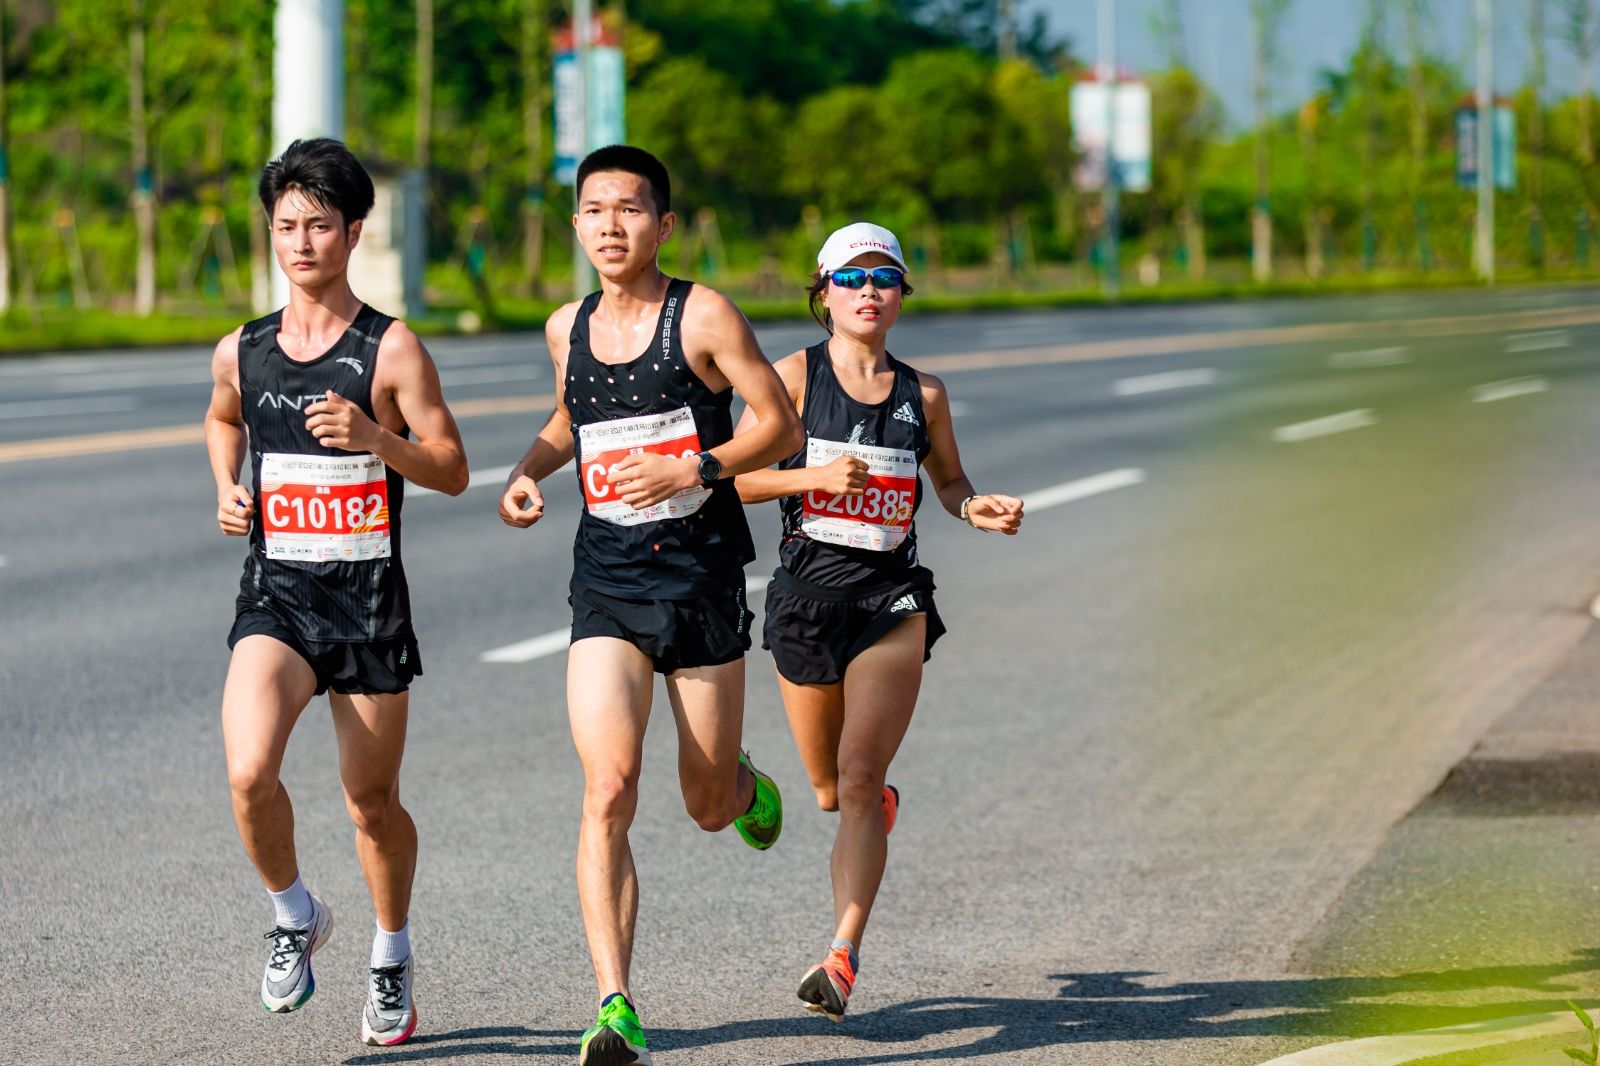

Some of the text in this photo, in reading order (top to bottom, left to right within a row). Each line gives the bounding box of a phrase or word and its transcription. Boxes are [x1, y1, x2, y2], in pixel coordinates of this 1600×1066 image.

[258, 391, 328, 410] ANT
[266, 493, 386, 530] C10182
[807, 487, 913, 521] C20385
[890, 602, 914, 613] adid
